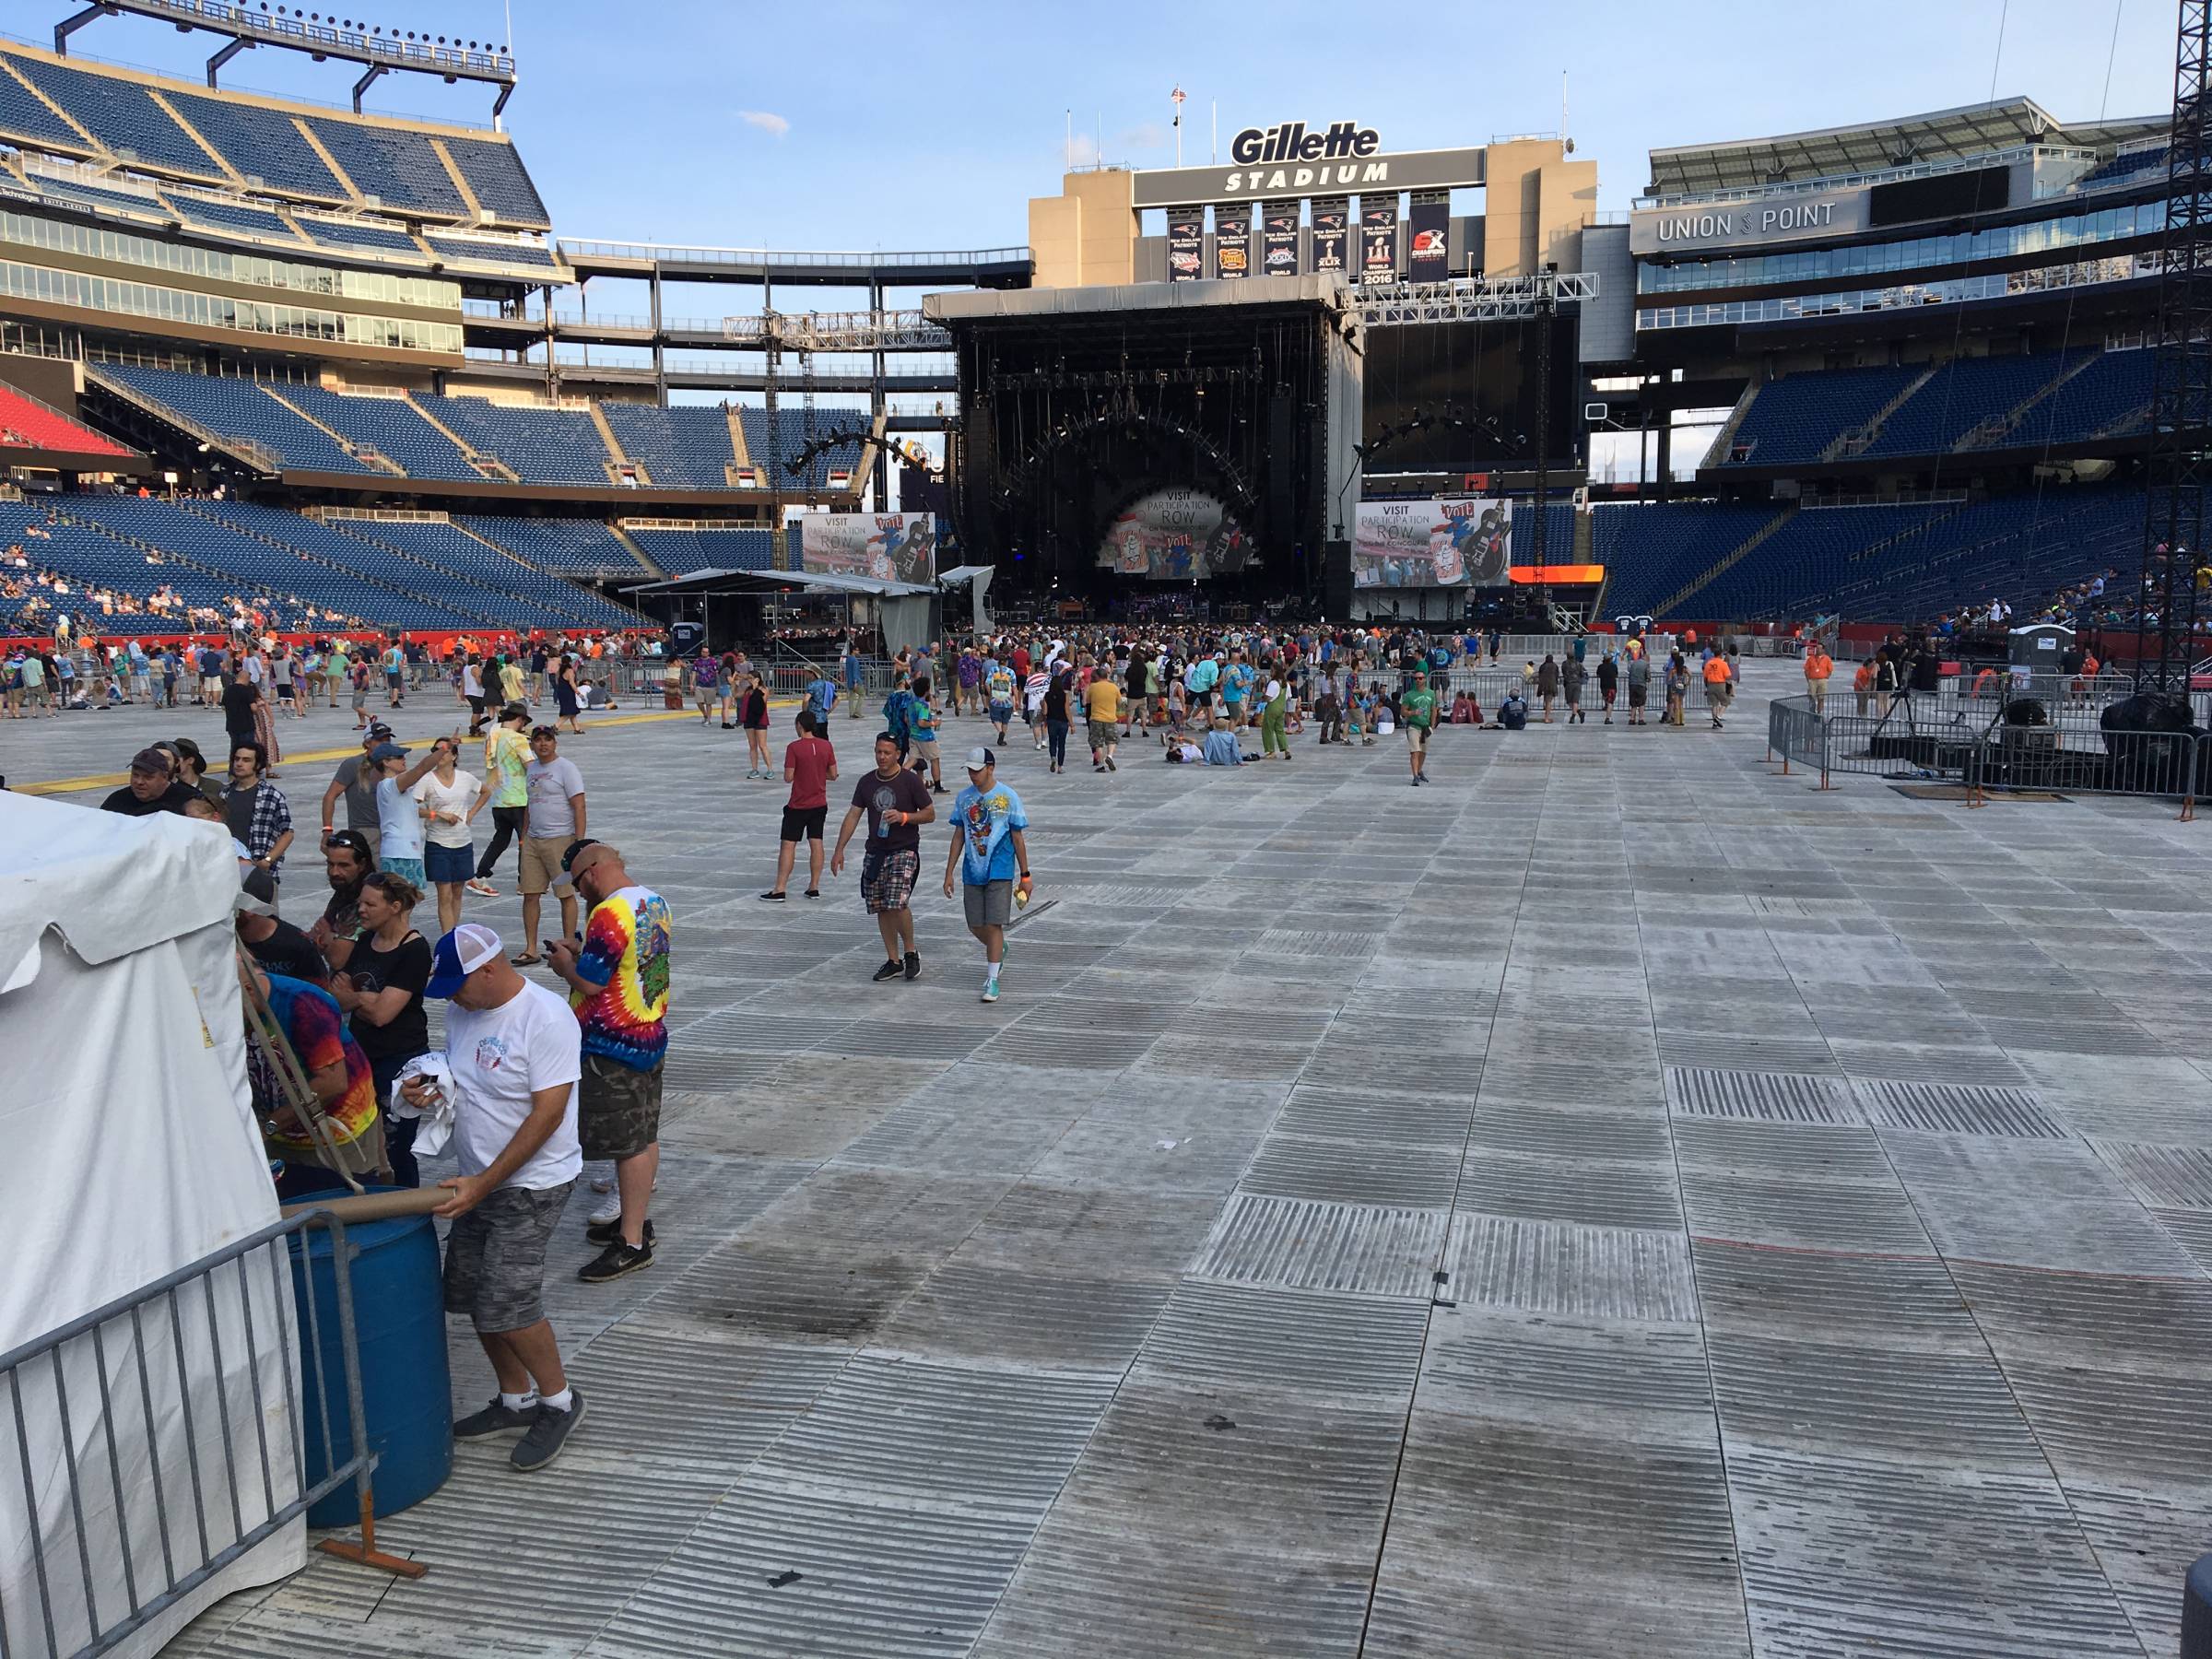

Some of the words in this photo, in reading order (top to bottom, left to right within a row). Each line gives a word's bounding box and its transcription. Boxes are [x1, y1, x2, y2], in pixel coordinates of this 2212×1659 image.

[1230, 121, 1380, 167] Gillette
[1224, 162, 1388, 192] STADIUM
[1659, 214, 1732, 241] UNION
[1762, 202, 1836, 231] POINT
[1412, 248, 1446, 256] CHAMPIONS
[1364, 276, 1393, 285] 2016
[1167, 491, 1191, 500] VISIT
[1147, 500, 1210, 511] PARTICIPATION
[1382, 505, 1409, 515] VISIT
[1445, 502, 1474, 518] VOTE
[826, 517, 848, 526] VISIT
[1162, 510, 1195, 524] ROW
[1361, 515, 1429, 526] PARTICIPATION
[807, 526, 865, 536] PARTICIPATION
[1377, 525, 1413, 539] ROW
[821, 535, 853, 548] ROW
[1168, 534, 1192, 547] VOTE
